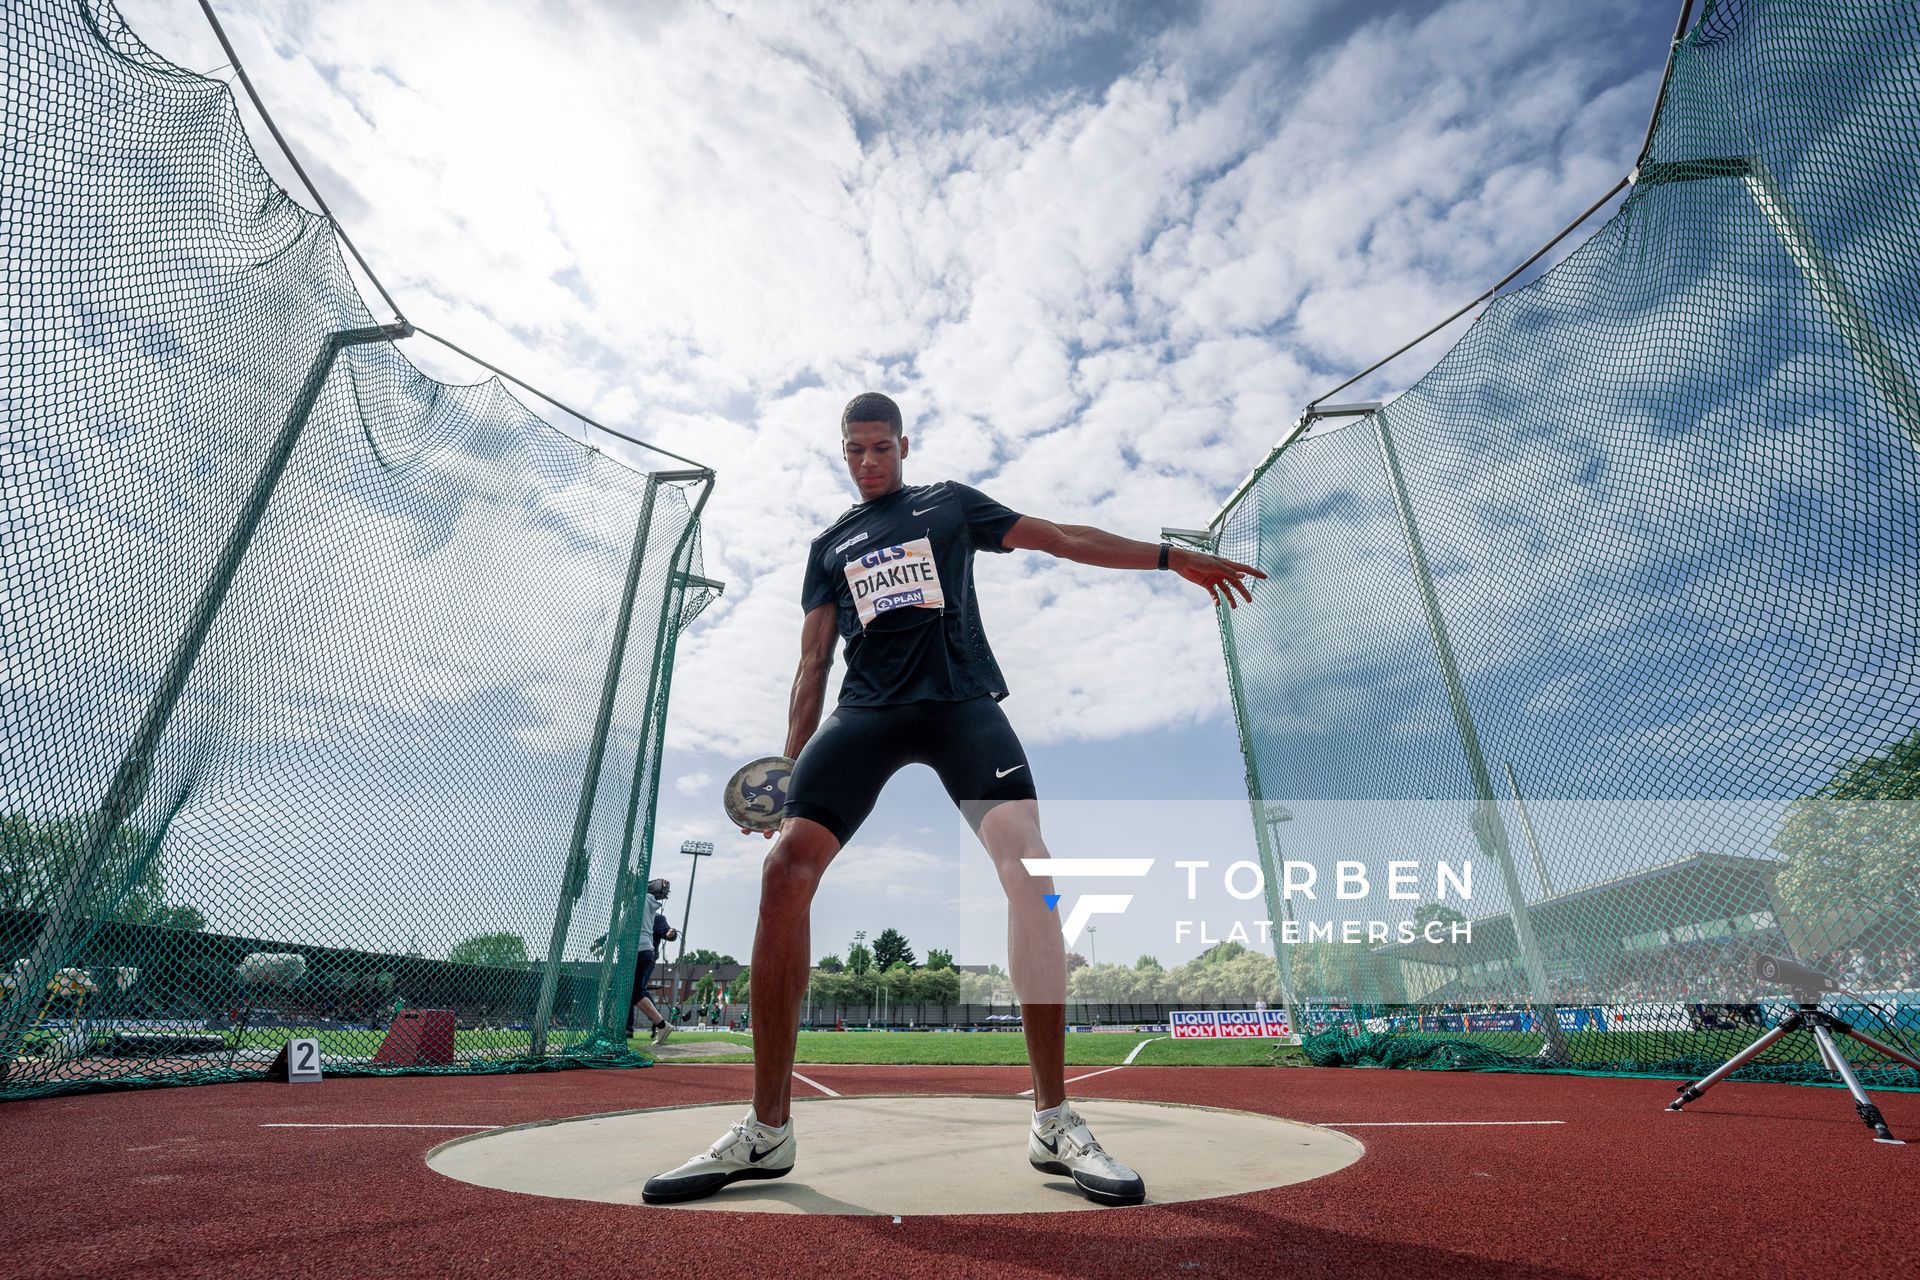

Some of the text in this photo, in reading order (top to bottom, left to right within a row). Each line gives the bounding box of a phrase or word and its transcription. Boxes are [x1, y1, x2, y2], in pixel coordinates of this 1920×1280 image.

[855, 557, 934, 599] DIAKITÉ
[893, 592, 922, 604] PLAN
[1174, 1013, 1214, 1025] LIQUI
[1220, 1012, 1259, 1024] LIQUI
[1265, 1011, 1288, 1024] LIQ
[1176, 1025, 1215, 1037] MOLY
[1221, 1024, 1261, 1037] MOLY
[1267, 1024, 1290, 1036] MO
[296, 1042, 315, 1070] 2
